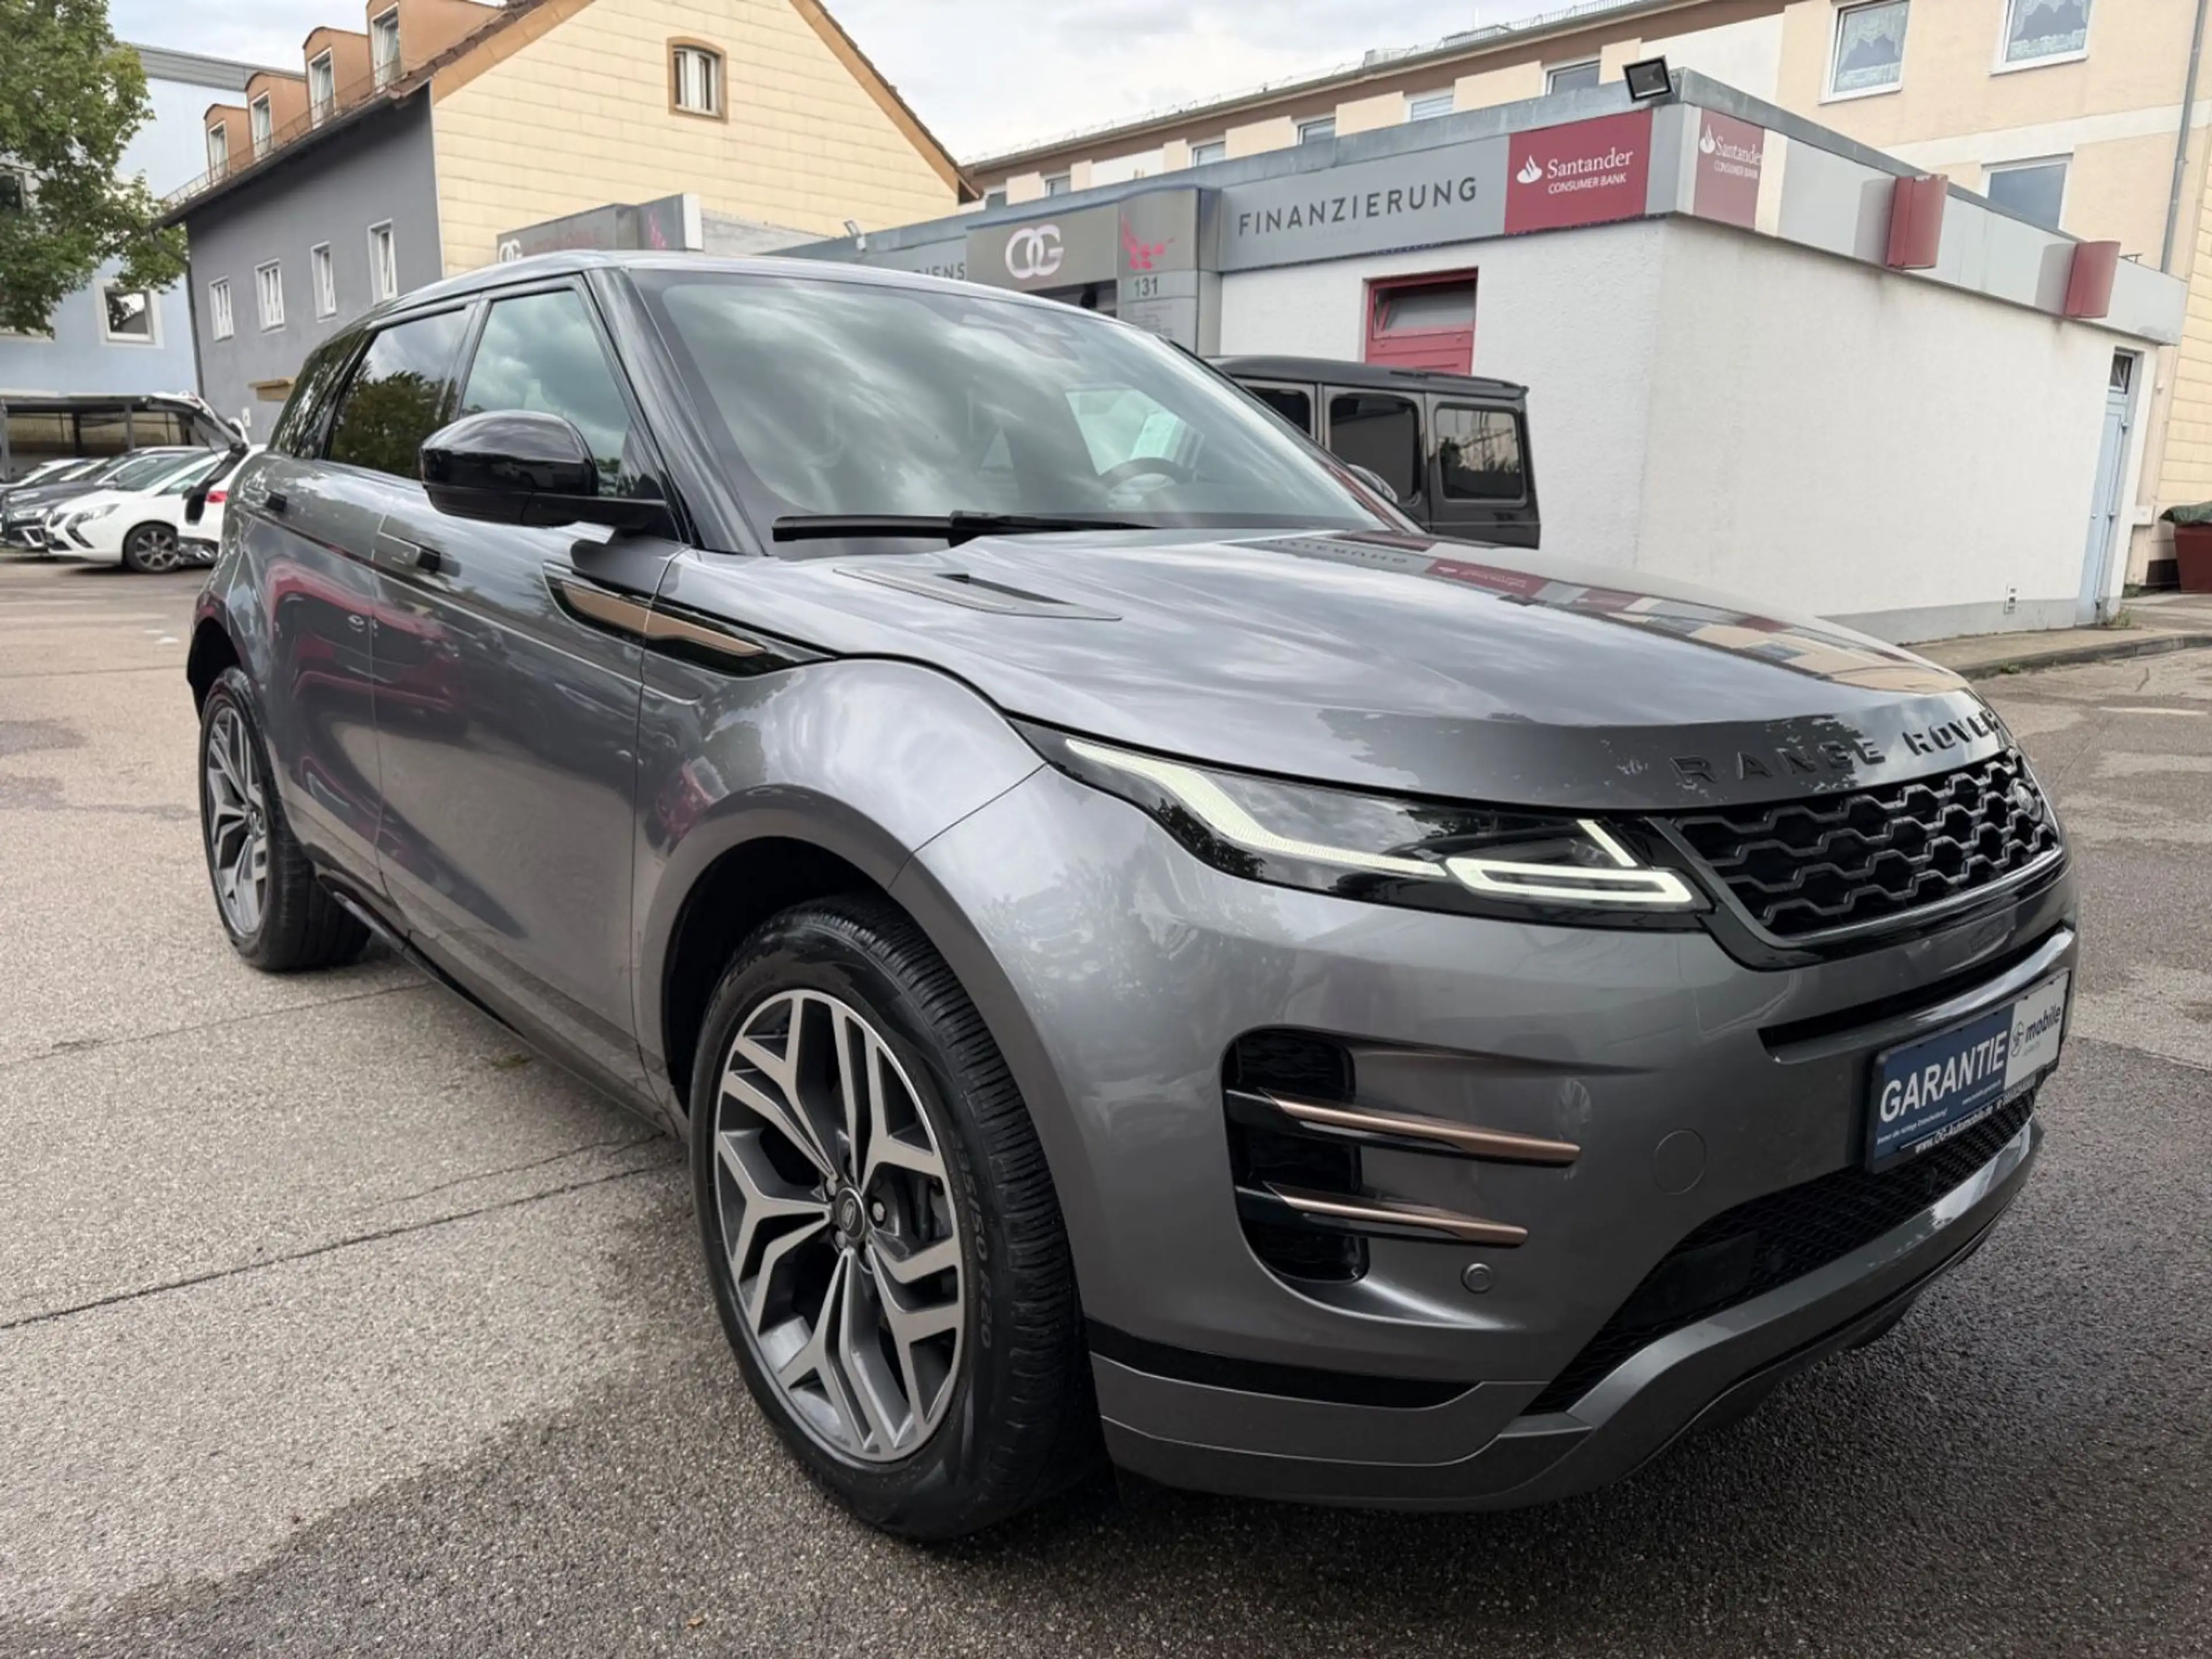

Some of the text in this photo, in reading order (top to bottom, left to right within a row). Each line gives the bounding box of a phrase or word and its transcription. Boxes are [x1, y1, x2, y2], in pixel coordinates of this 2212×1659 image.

[1547, 146, 1634, 180] Santander
[1548, 172, 1627, 195] CONSUMER BANK
[1238, 177, 1477, 237] FINANZIERUNG
[1134, 276, 1158, 297] 131
[1671, 709, 2002, 786] RANGE ROVER
[1880, 1031, 2008, 1123] GARANTIE
